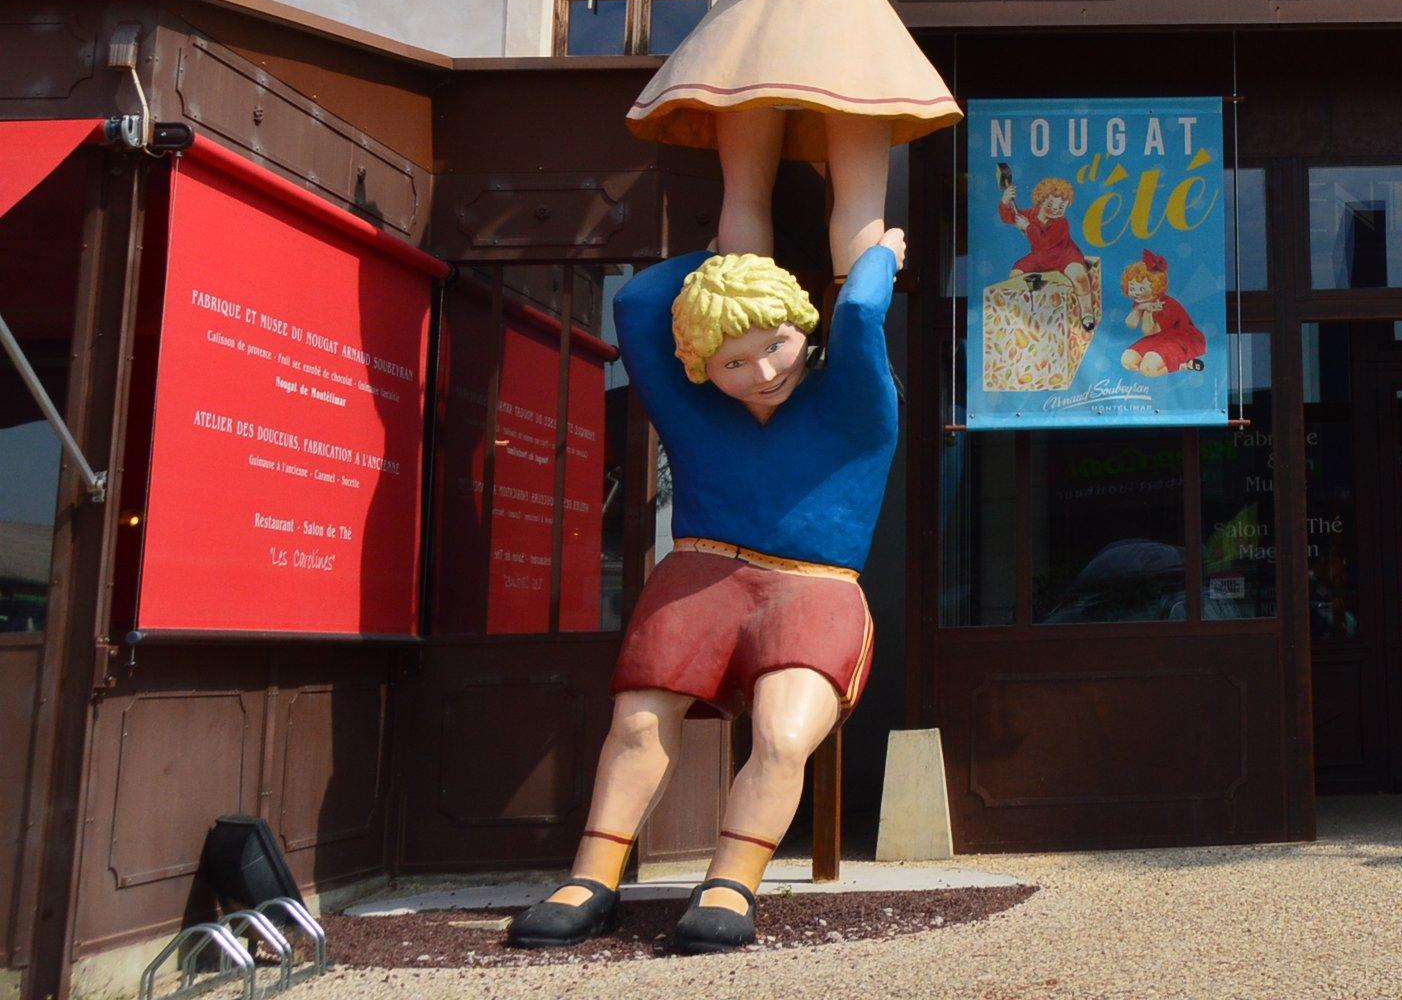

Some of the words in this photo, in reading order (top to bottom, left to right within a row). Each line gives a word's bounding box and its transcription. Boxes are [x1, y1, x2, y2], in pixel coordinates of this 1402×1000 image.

[990, 117, 1197, 158] NOUGAT
[191, 289, 242, 320] FABRIQUE
[245, 308, 257, 325] ET
[260, 314, 288, 336] MUSEE
[291, 325, 303, 342] DU
[305, 331, 339, 355] NOUGAT
[341, 344, 371, 366] ARNAUD
[373, 356, 414, 383] SOUBEYRAN
[207, 329, 236, 348] Calisson
[237, 340, 246, 351] de
[322, 368, 330, 380] de
[275, 375, 298, 394] Nougat
[300, 384, 309, 396] de
[193, 409, 233, 433] ATELIER
[236, 420, 255, 438] DES
[257, 425, 301, 452] DOUCEURS,
[303, 438, 353, 463] FABRICATION
[354, 451, 361, 465] A
[254, 512, 295, 532] Restaurant
[303, 520, 324, 537] Salon
[326, 523, 336, 538] de
[339, 525, 352, 540] Thé
[1213, 521, 1269, 539] Salon
[1306, 516, 1344, 534] Thé
